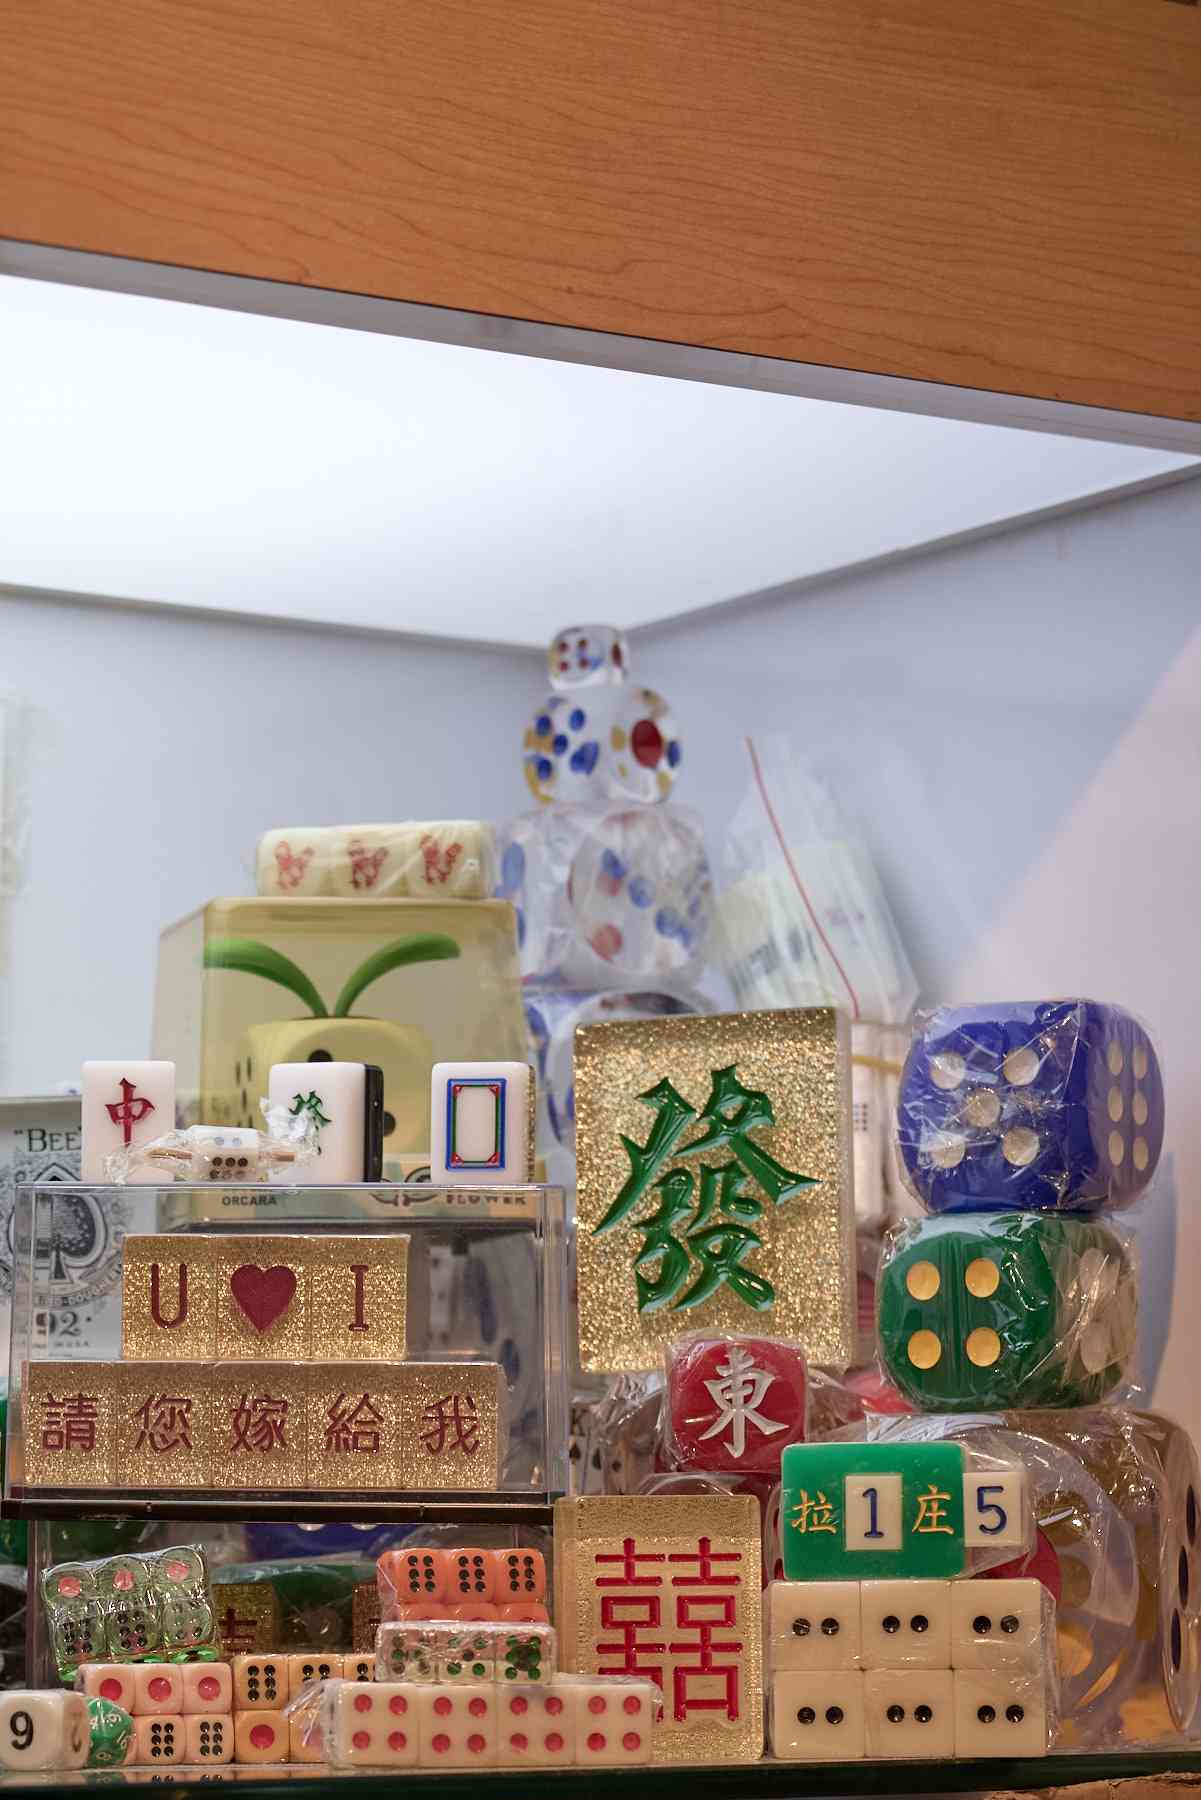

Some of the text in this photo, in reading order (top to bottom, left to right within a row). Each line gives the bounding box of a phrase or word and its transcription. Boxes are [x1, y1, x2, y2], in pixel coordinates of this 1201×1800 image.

[104, 1077, 155, 1147] 中
[593, 1064, 823, 1314] 發
[150, 1263, 188, 1329] U
[348, 1263, 370, 1332] I
[40, 1391, 482, 1456] 請您嫁給我
[698, 1346, 789, 1459] 東
